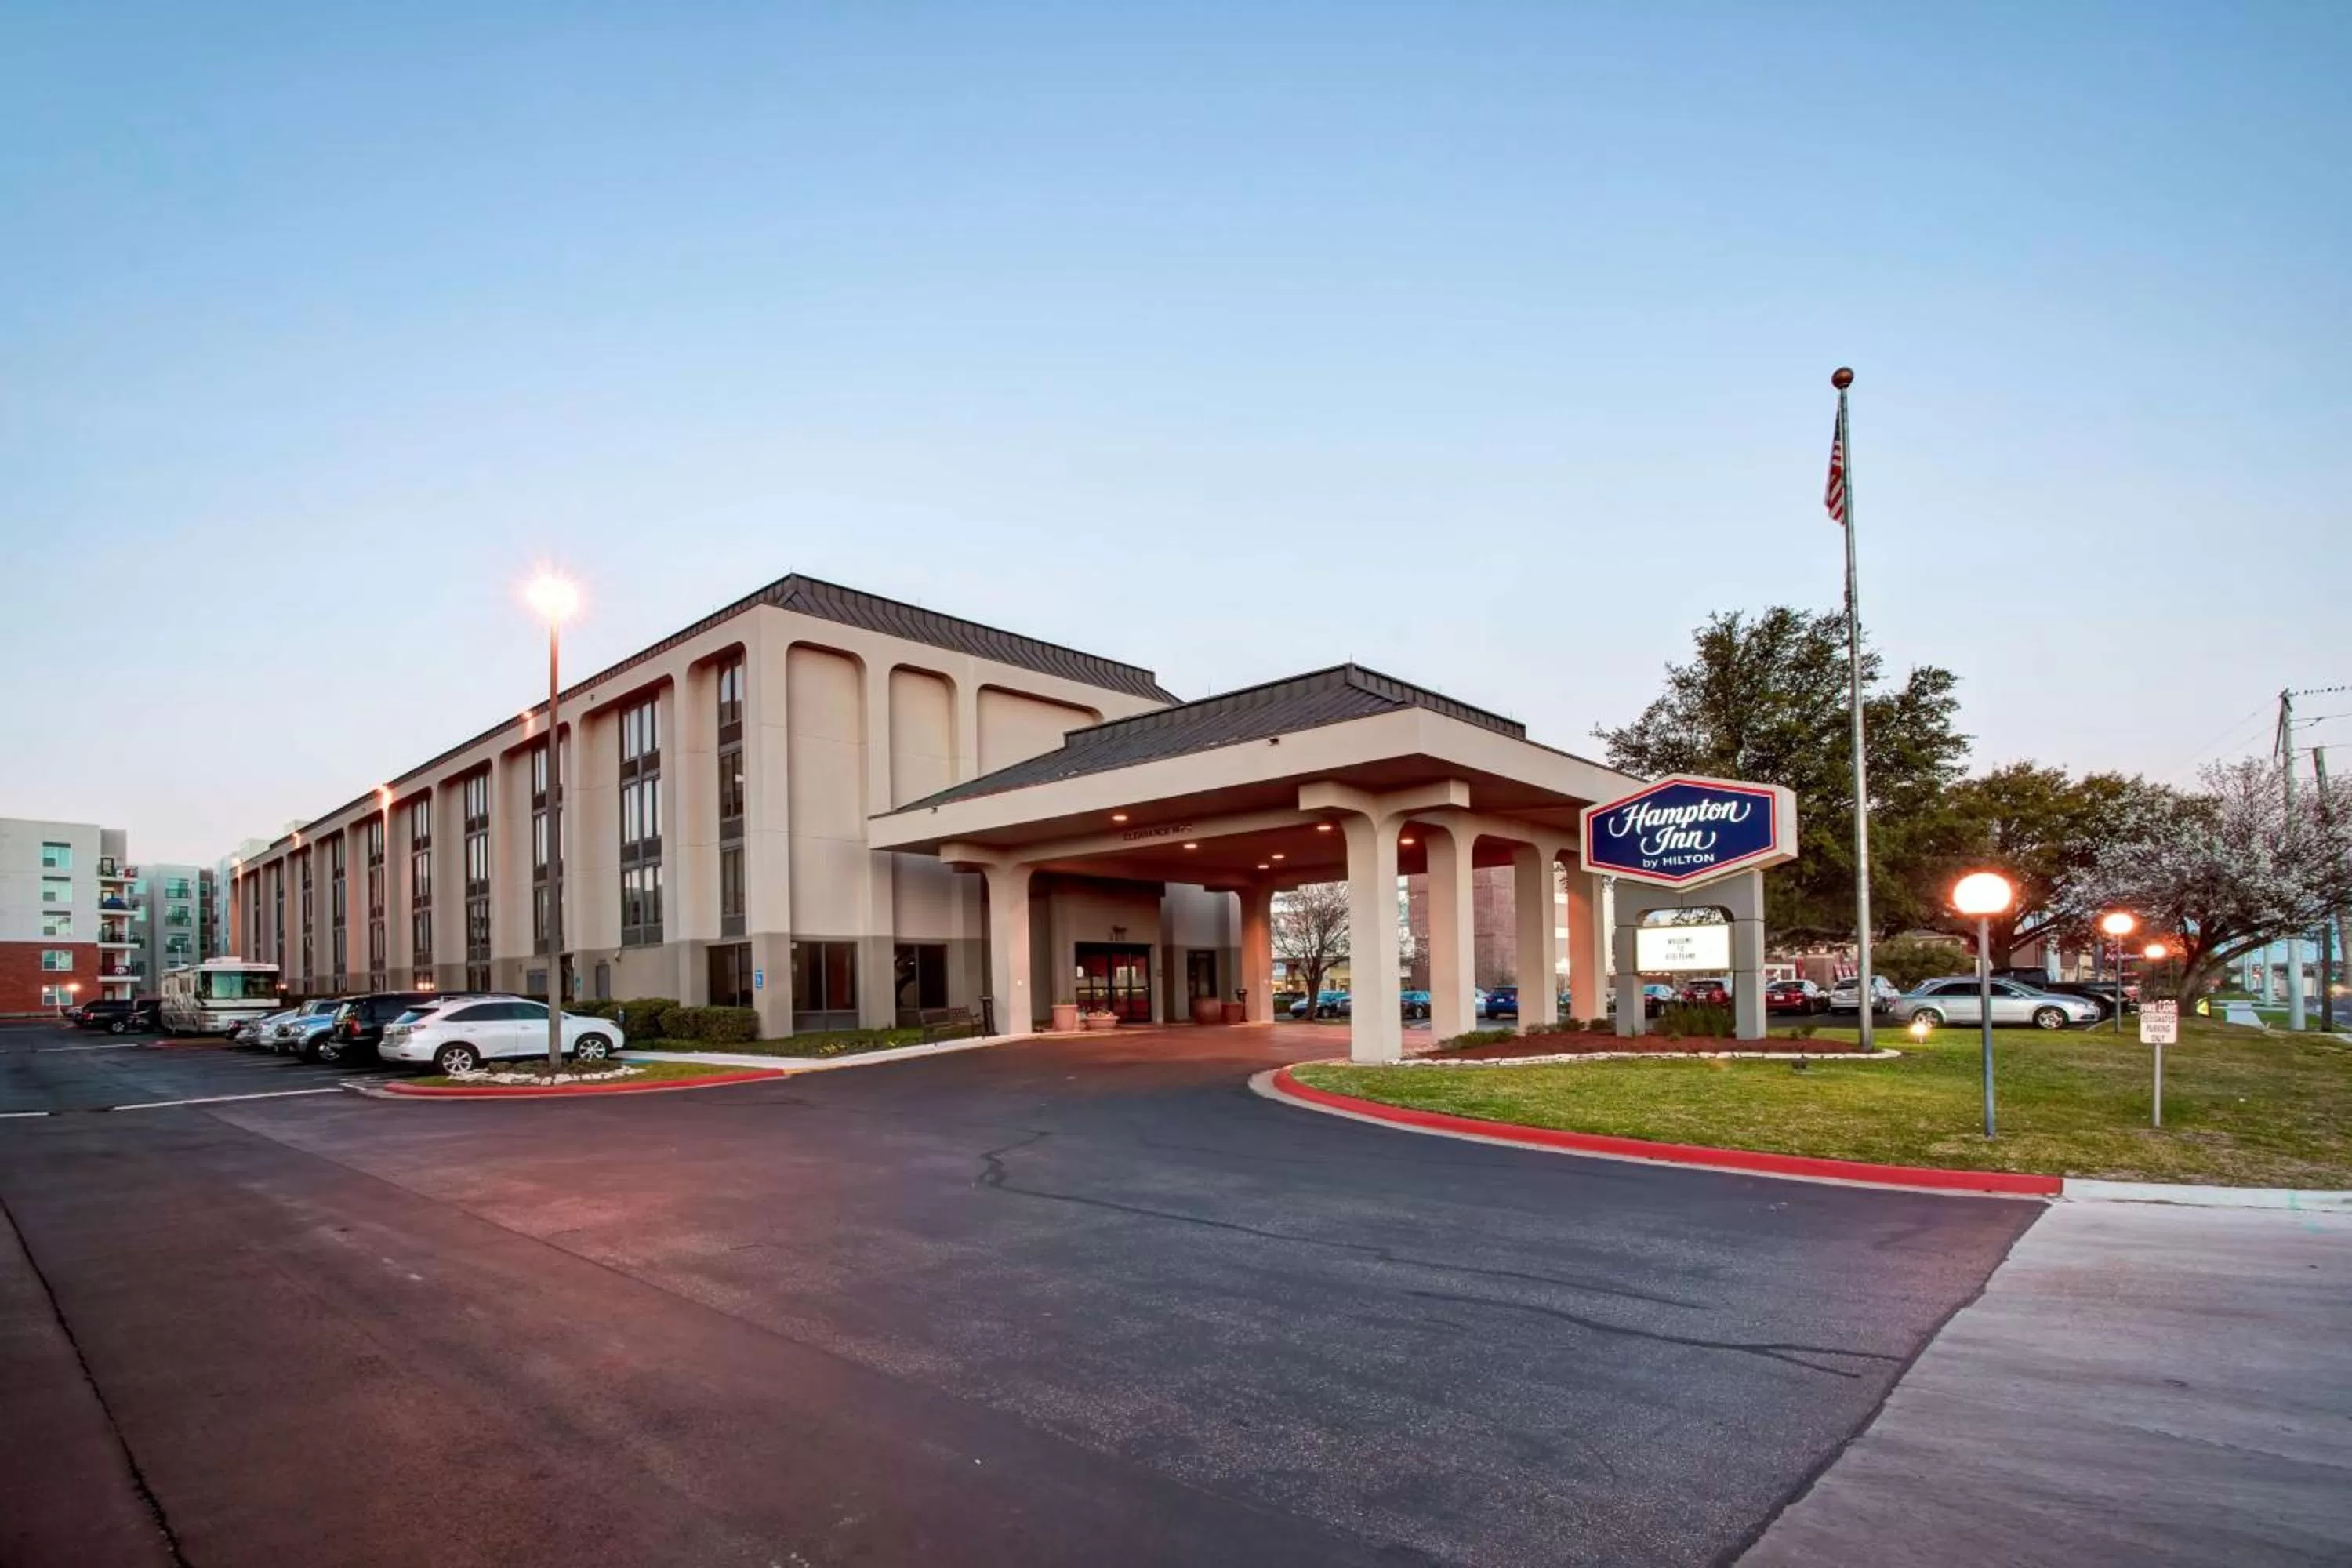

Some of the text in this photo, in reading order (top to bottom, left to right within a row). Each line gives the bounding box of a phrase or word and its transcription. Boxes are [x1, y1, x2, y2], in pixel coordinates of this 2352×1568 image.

[1608, 798, 1751, 837] Hampton
[1640, 826, 1716, 855] Inn
[1642, 853, 1715, 869] by HILTON
